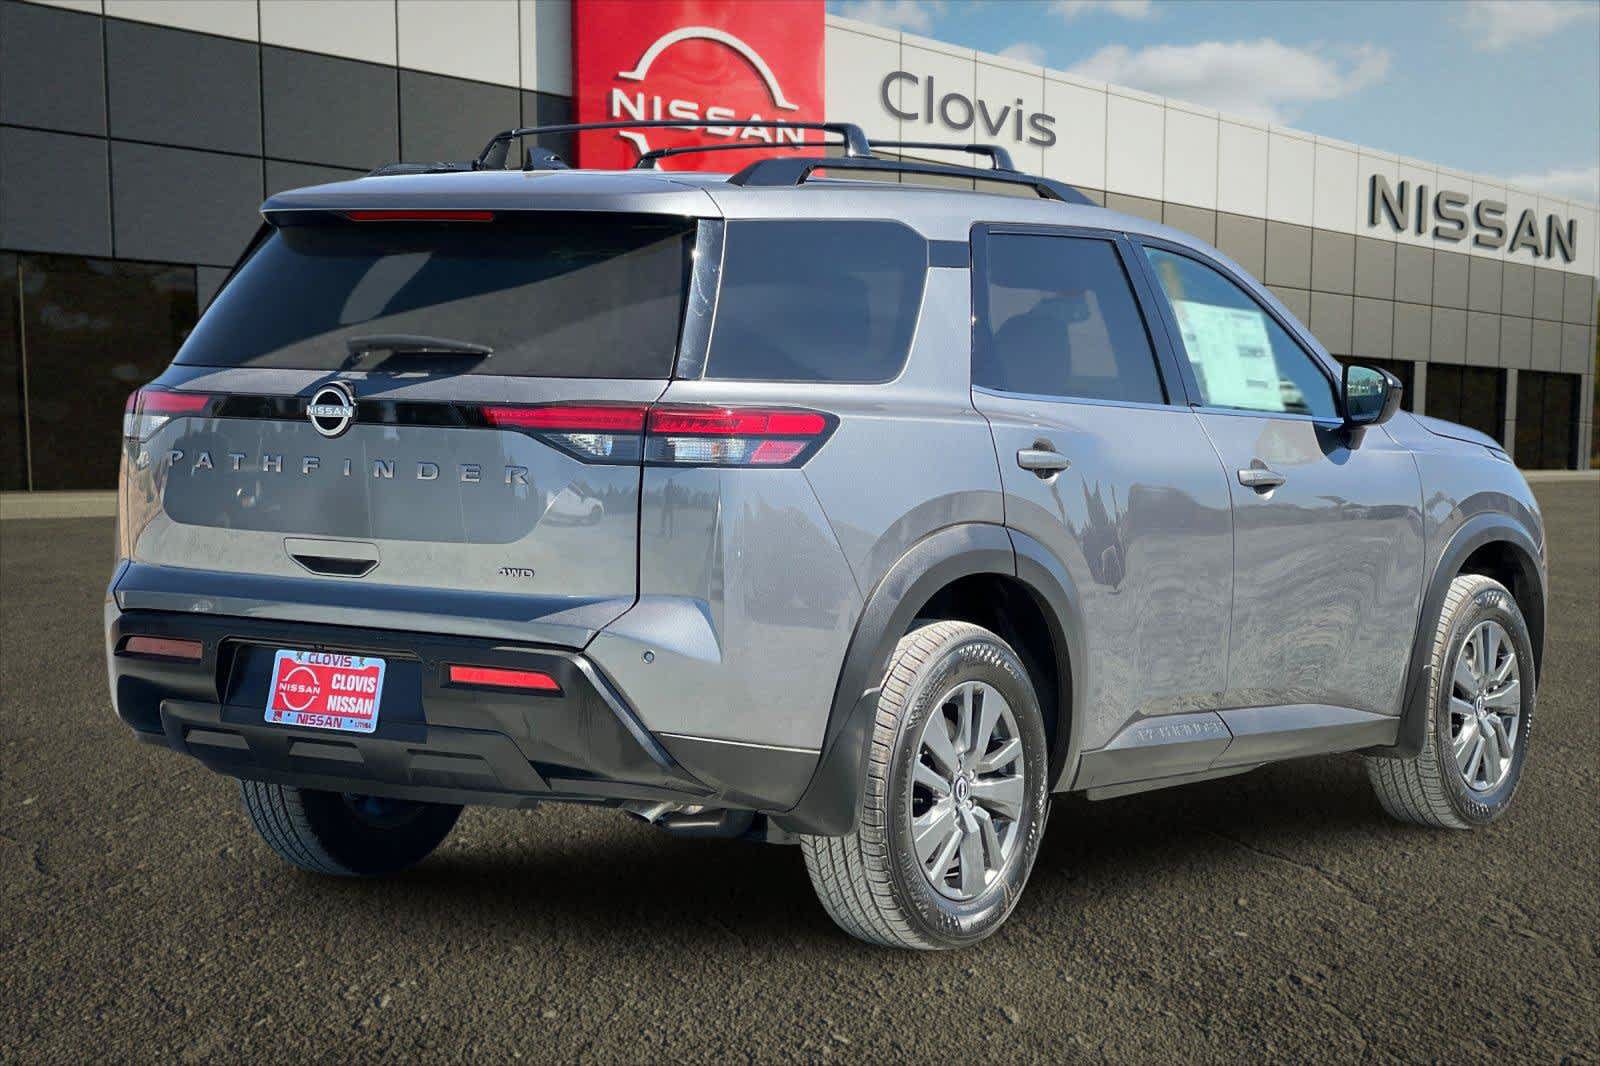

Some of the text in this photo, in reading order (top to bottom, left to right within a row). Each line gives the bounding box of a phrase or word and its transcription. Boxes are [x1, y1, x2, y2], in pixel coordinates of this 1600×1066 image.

[612, 88, 805, 147] NISSAN
[882, 71, 1057, 147] Clovis
[1368, 174, 1577, 263] NISSAN
[306, 405, 352, 417] NISSAN
[167, 449, 530, 485] PATHFINDER
[496, 567, 535, 577] 4WD
[308, 653, 352, 667] CLOVIS
[279, 682, 320, 695] NISSAN
[331, 673, 376, 693] CLOVIS
[327, 695, 374, 714] NISSAN
[296, 713, 342, 728] NISSAN
